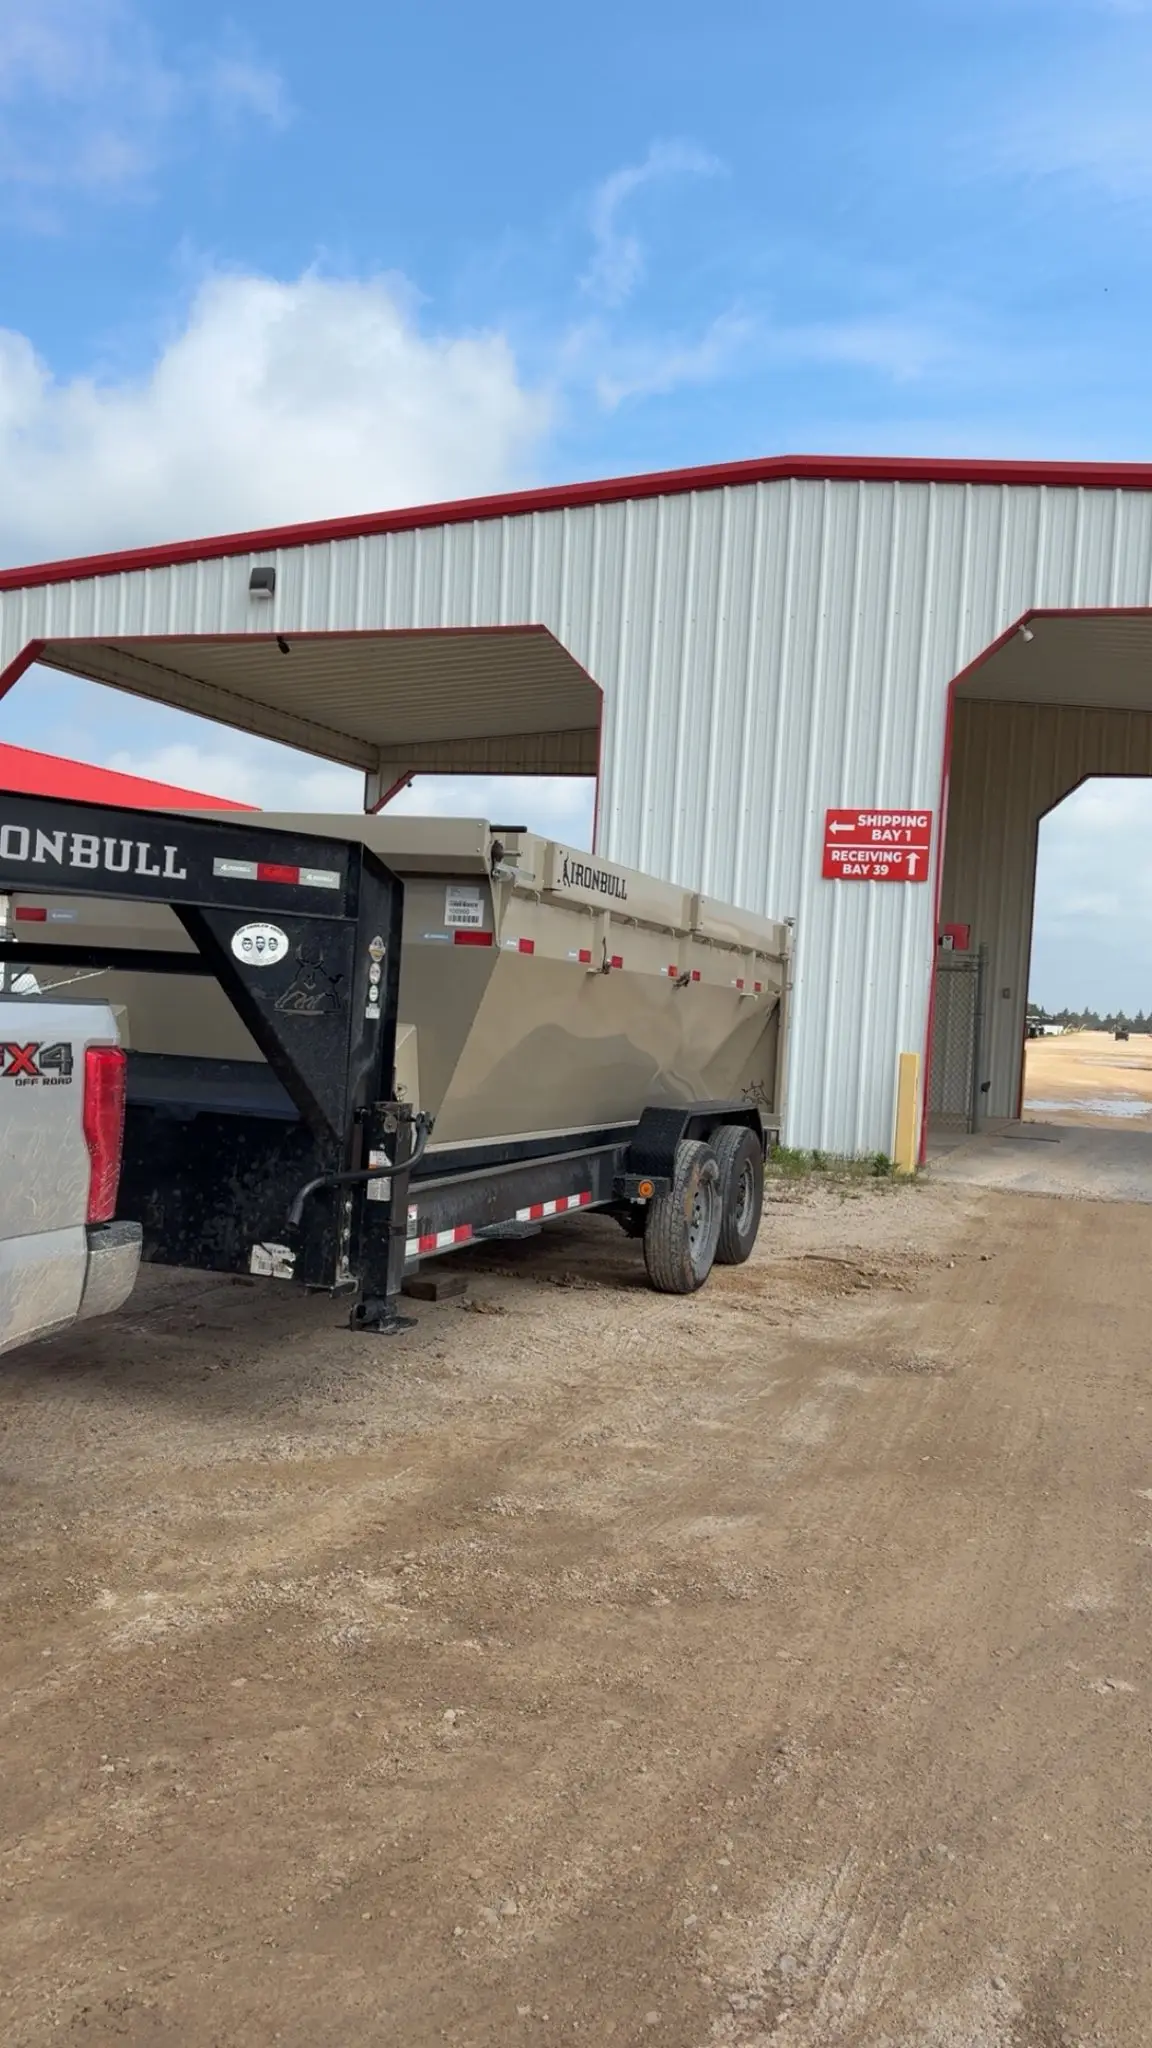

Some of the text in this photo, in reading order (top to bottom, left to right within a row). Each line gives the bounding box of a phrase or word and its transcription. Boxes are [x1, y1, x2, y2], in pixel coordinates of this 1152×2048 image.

[857, 814, 928, 828] SHIPPING
[871, 829, 912, 842] BAY 1
[0, 825, 187, 880] ONBULL
[831, 850, 902, 863] RECEIVING
[842, 863, 889, 875] BAY 39
[570, 861, 628, 900] IRONBULL
[0, 1042, 73, 1077] X4
[15, 1077, 73, 1087] OFF ROAD
